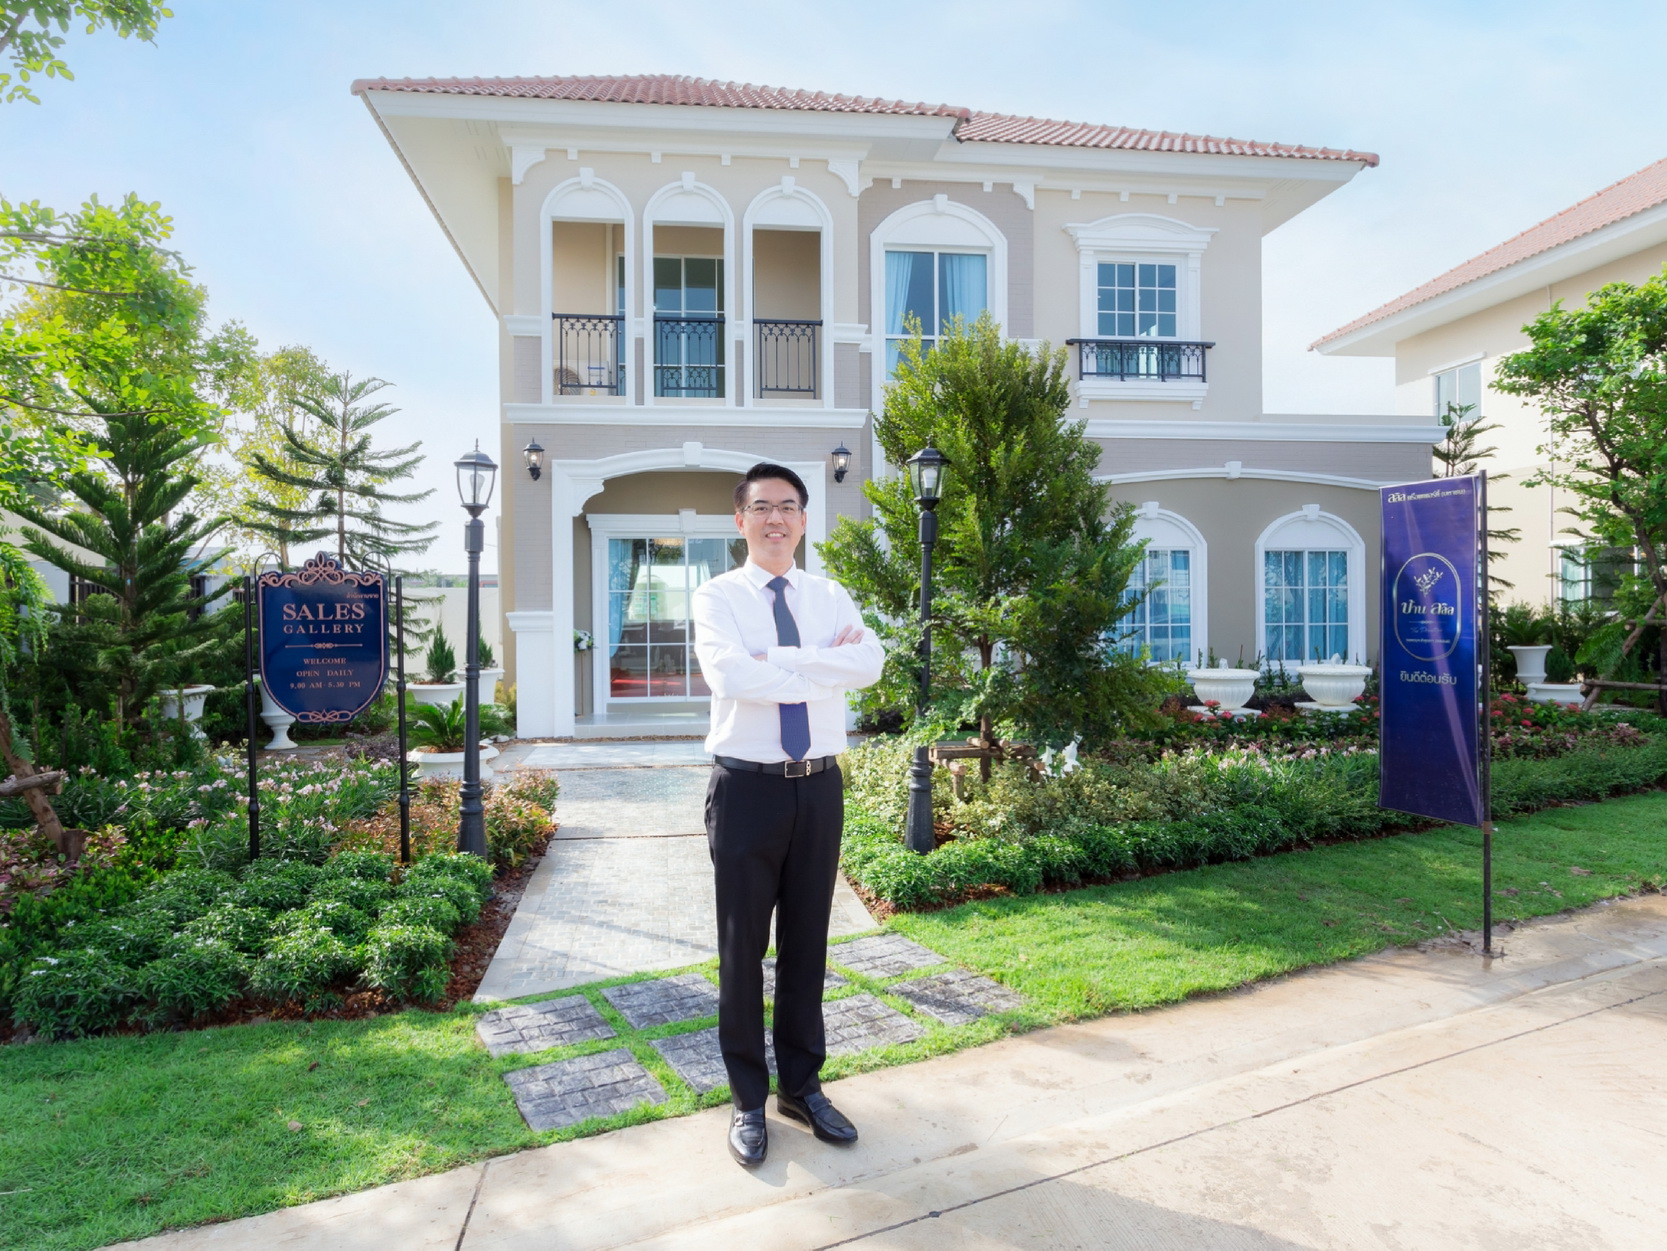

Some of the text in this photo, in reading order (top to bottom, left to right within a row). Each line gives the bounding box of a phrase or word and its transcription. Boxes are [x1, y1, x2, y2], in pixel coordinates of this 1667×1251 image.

[283, 603, 365, 620] SALES
[1401, 599, 1426, 614] บ้าน
[283, 624, 364, 634] GALLERY
[303, 657, 347, 665] WELCOME
[296, 669, 353, 677] OPEN DAILY
[1400, 671, 1457, 685] ยินดีต้อนรับ
[289, 682, 306, 690] 9.00
